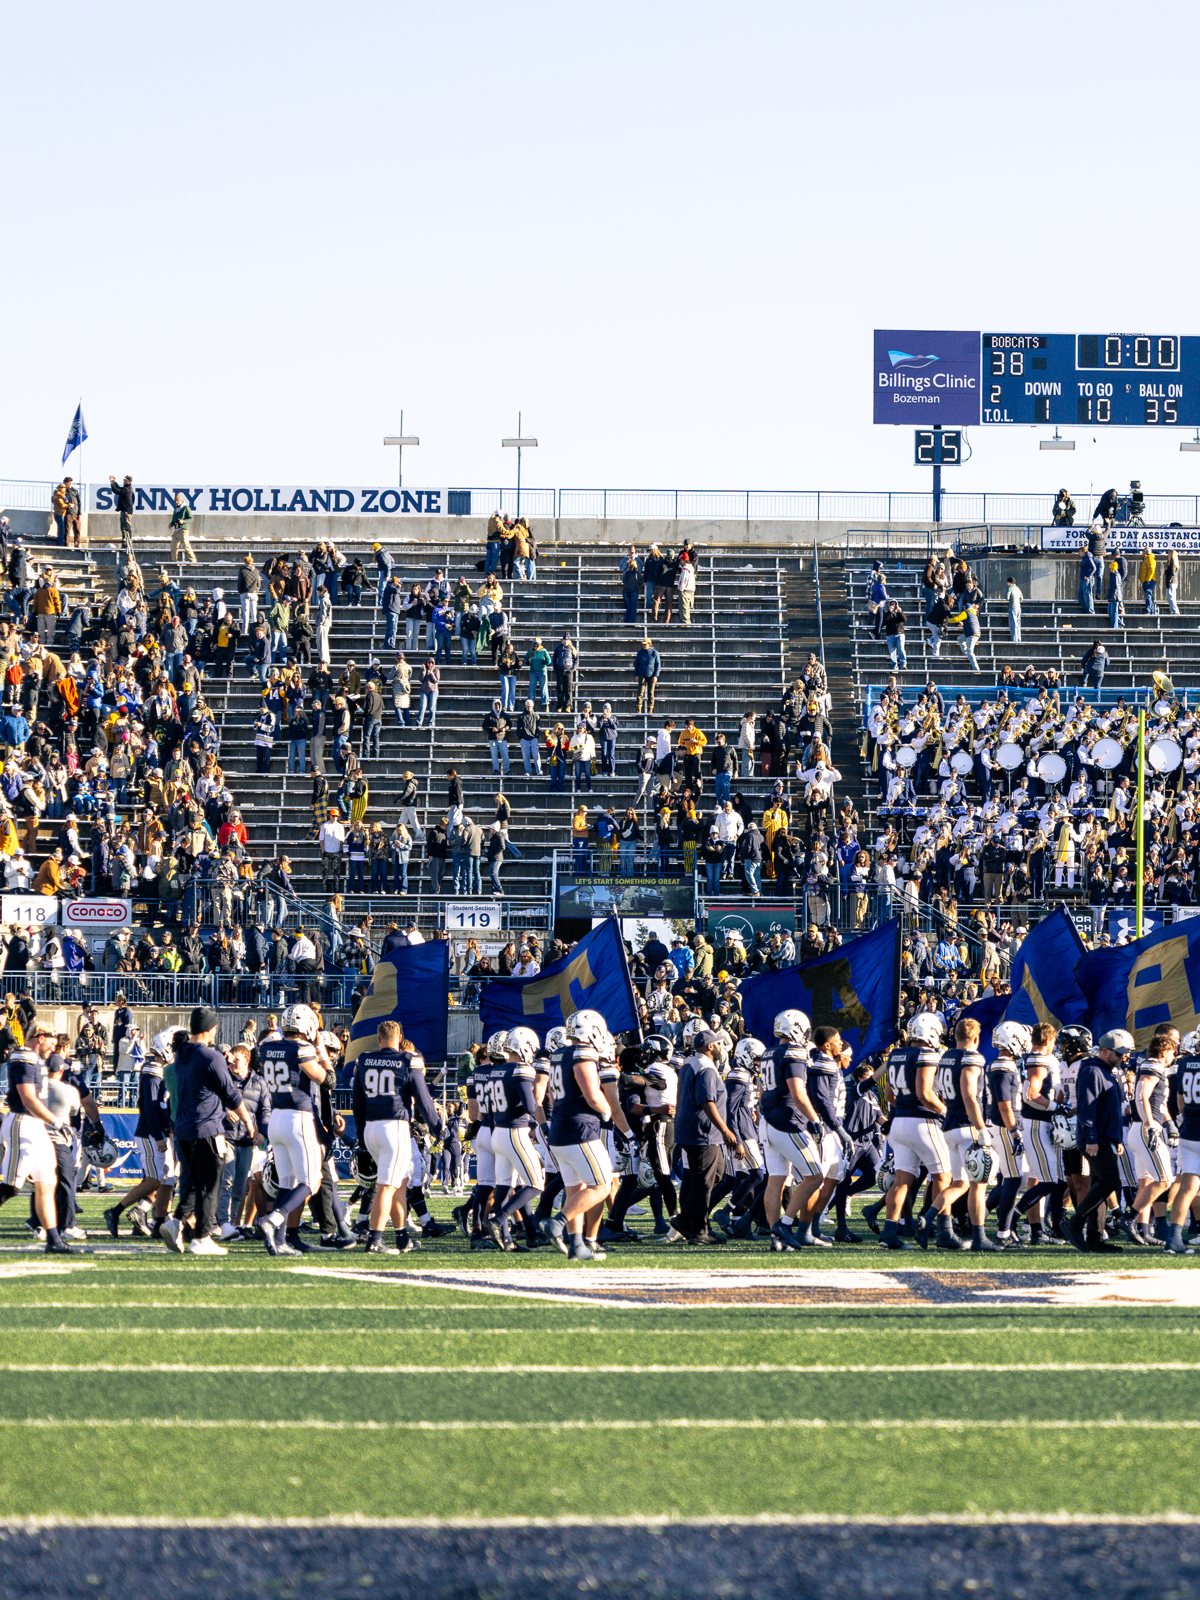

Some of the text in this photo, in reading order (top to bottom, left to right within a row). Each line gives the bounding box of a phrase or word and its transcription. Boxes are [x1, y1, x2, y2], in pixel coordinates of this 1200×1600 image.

[991, 336, 1040, 348] BOBCATS
[1105, 337, 1174, 367] 0:00
[992, 352, 1024, 375] 38
[879, 372, 976, 391] Billings Clinic
[990, 385, 1001, 403] 2
[1024, 382, 1062, 396] DOWN
[1078, 383, 1113, 396] TO GO
[1140, 384, 1183, 397] BALL ON
[893, 393, 940, 403] Bozeman
[984, 408, 1014, 422] T.O.L.
[1088, 399, 1111, 421] 10
[1146, 399, 1177, 422] 35
[918, 432, 958, 461] 25
[209, 488, 355, 512] HOLLAND
[361, 489, 441, 513] ZONE
[1120, 531, 1137, 540] DAY
[1157, 541, 1169, 549] TO
[13, 907, 46, 921] 118
[456, 912, 491, 927] 119
[769, 921, 782, 932] Go
[266, 1050, 286, 1058] SMITH
[364, 1058, 402, 1068] SHARBONO
[364, 1069, 396, 1098] 90
